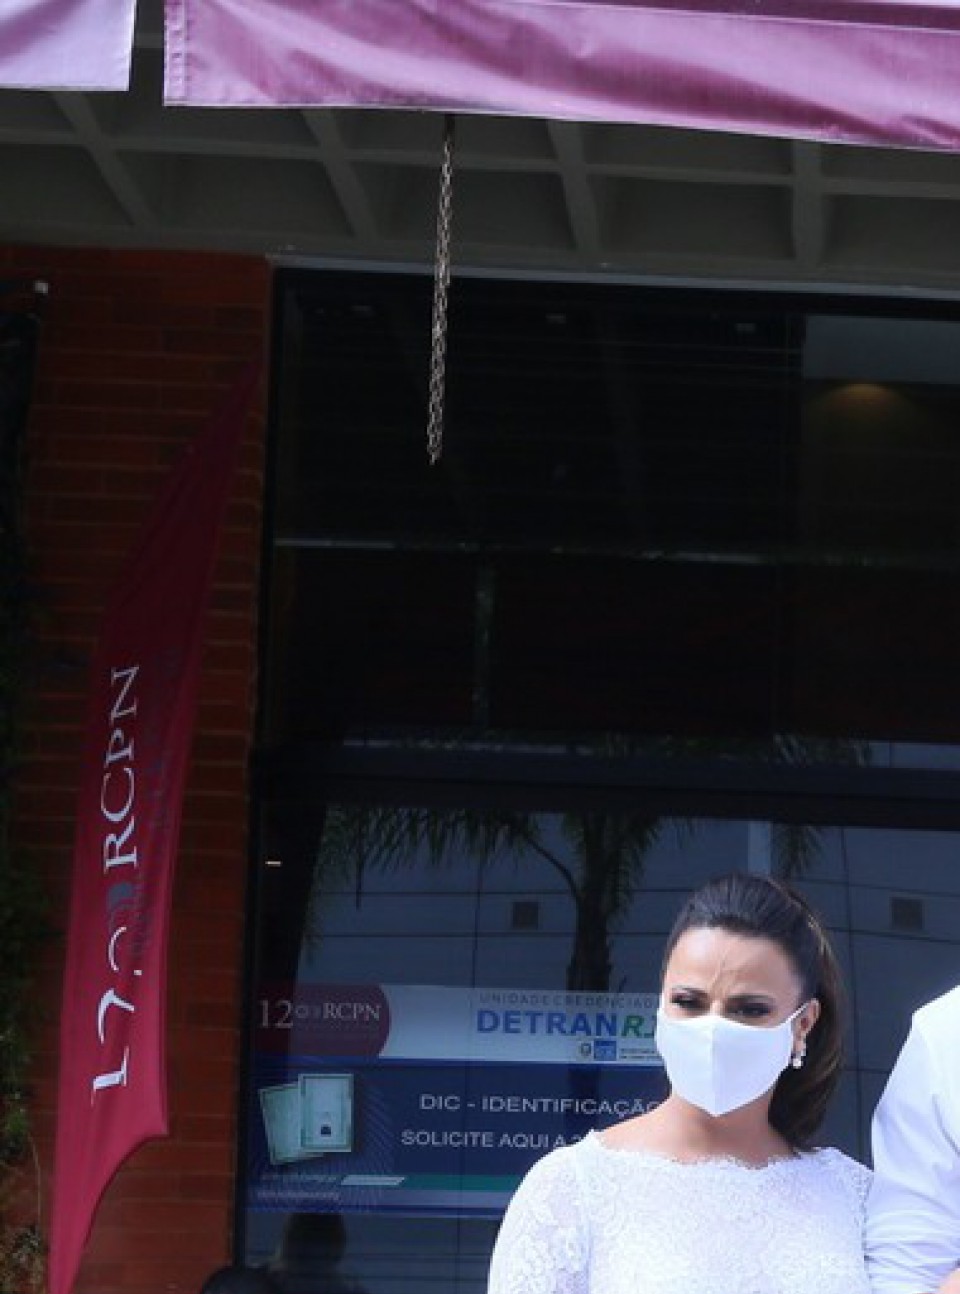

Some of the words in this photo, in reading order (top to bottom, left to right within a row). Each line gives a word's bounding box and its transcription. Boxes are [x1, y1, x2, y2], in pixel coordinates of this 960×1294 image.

[101, 664, 139, 874] RCPN
[552, 993, 661, 1009] CREDENCIAD
[323, 1002, 381, 1021] RCPN
[419, 1093, 461, 1111] DIC
[401, 1131, 494, 1147] SOLICITE
[499, 1134, 549, 1149] AQUI
